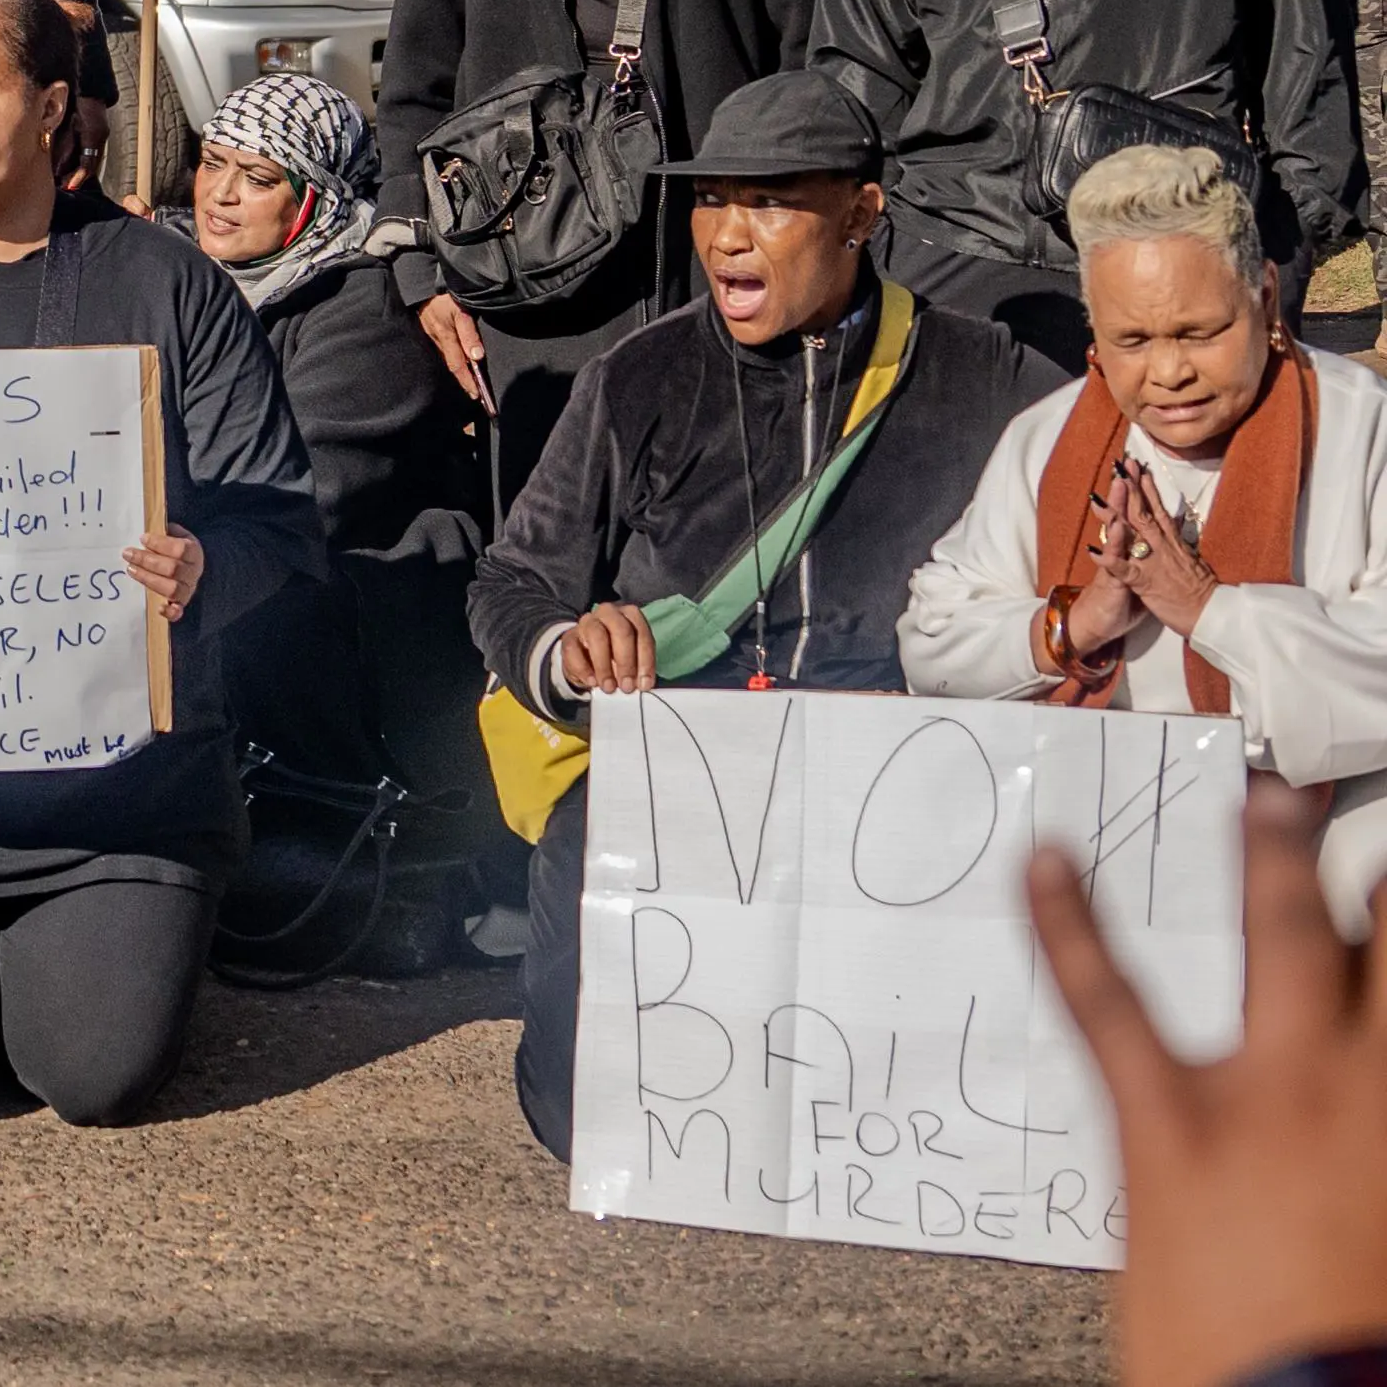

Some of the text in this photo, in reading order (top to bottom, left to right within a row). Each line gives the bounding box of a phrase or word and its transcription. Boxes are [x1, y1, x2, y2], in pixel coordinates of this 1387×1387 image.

[57, 622, 106, 647] NO
[635, 690, 998, 906] NO
[644, 1108, 1129, 1241] MURDERE
[811, 1100, 964, 1160] FOR
